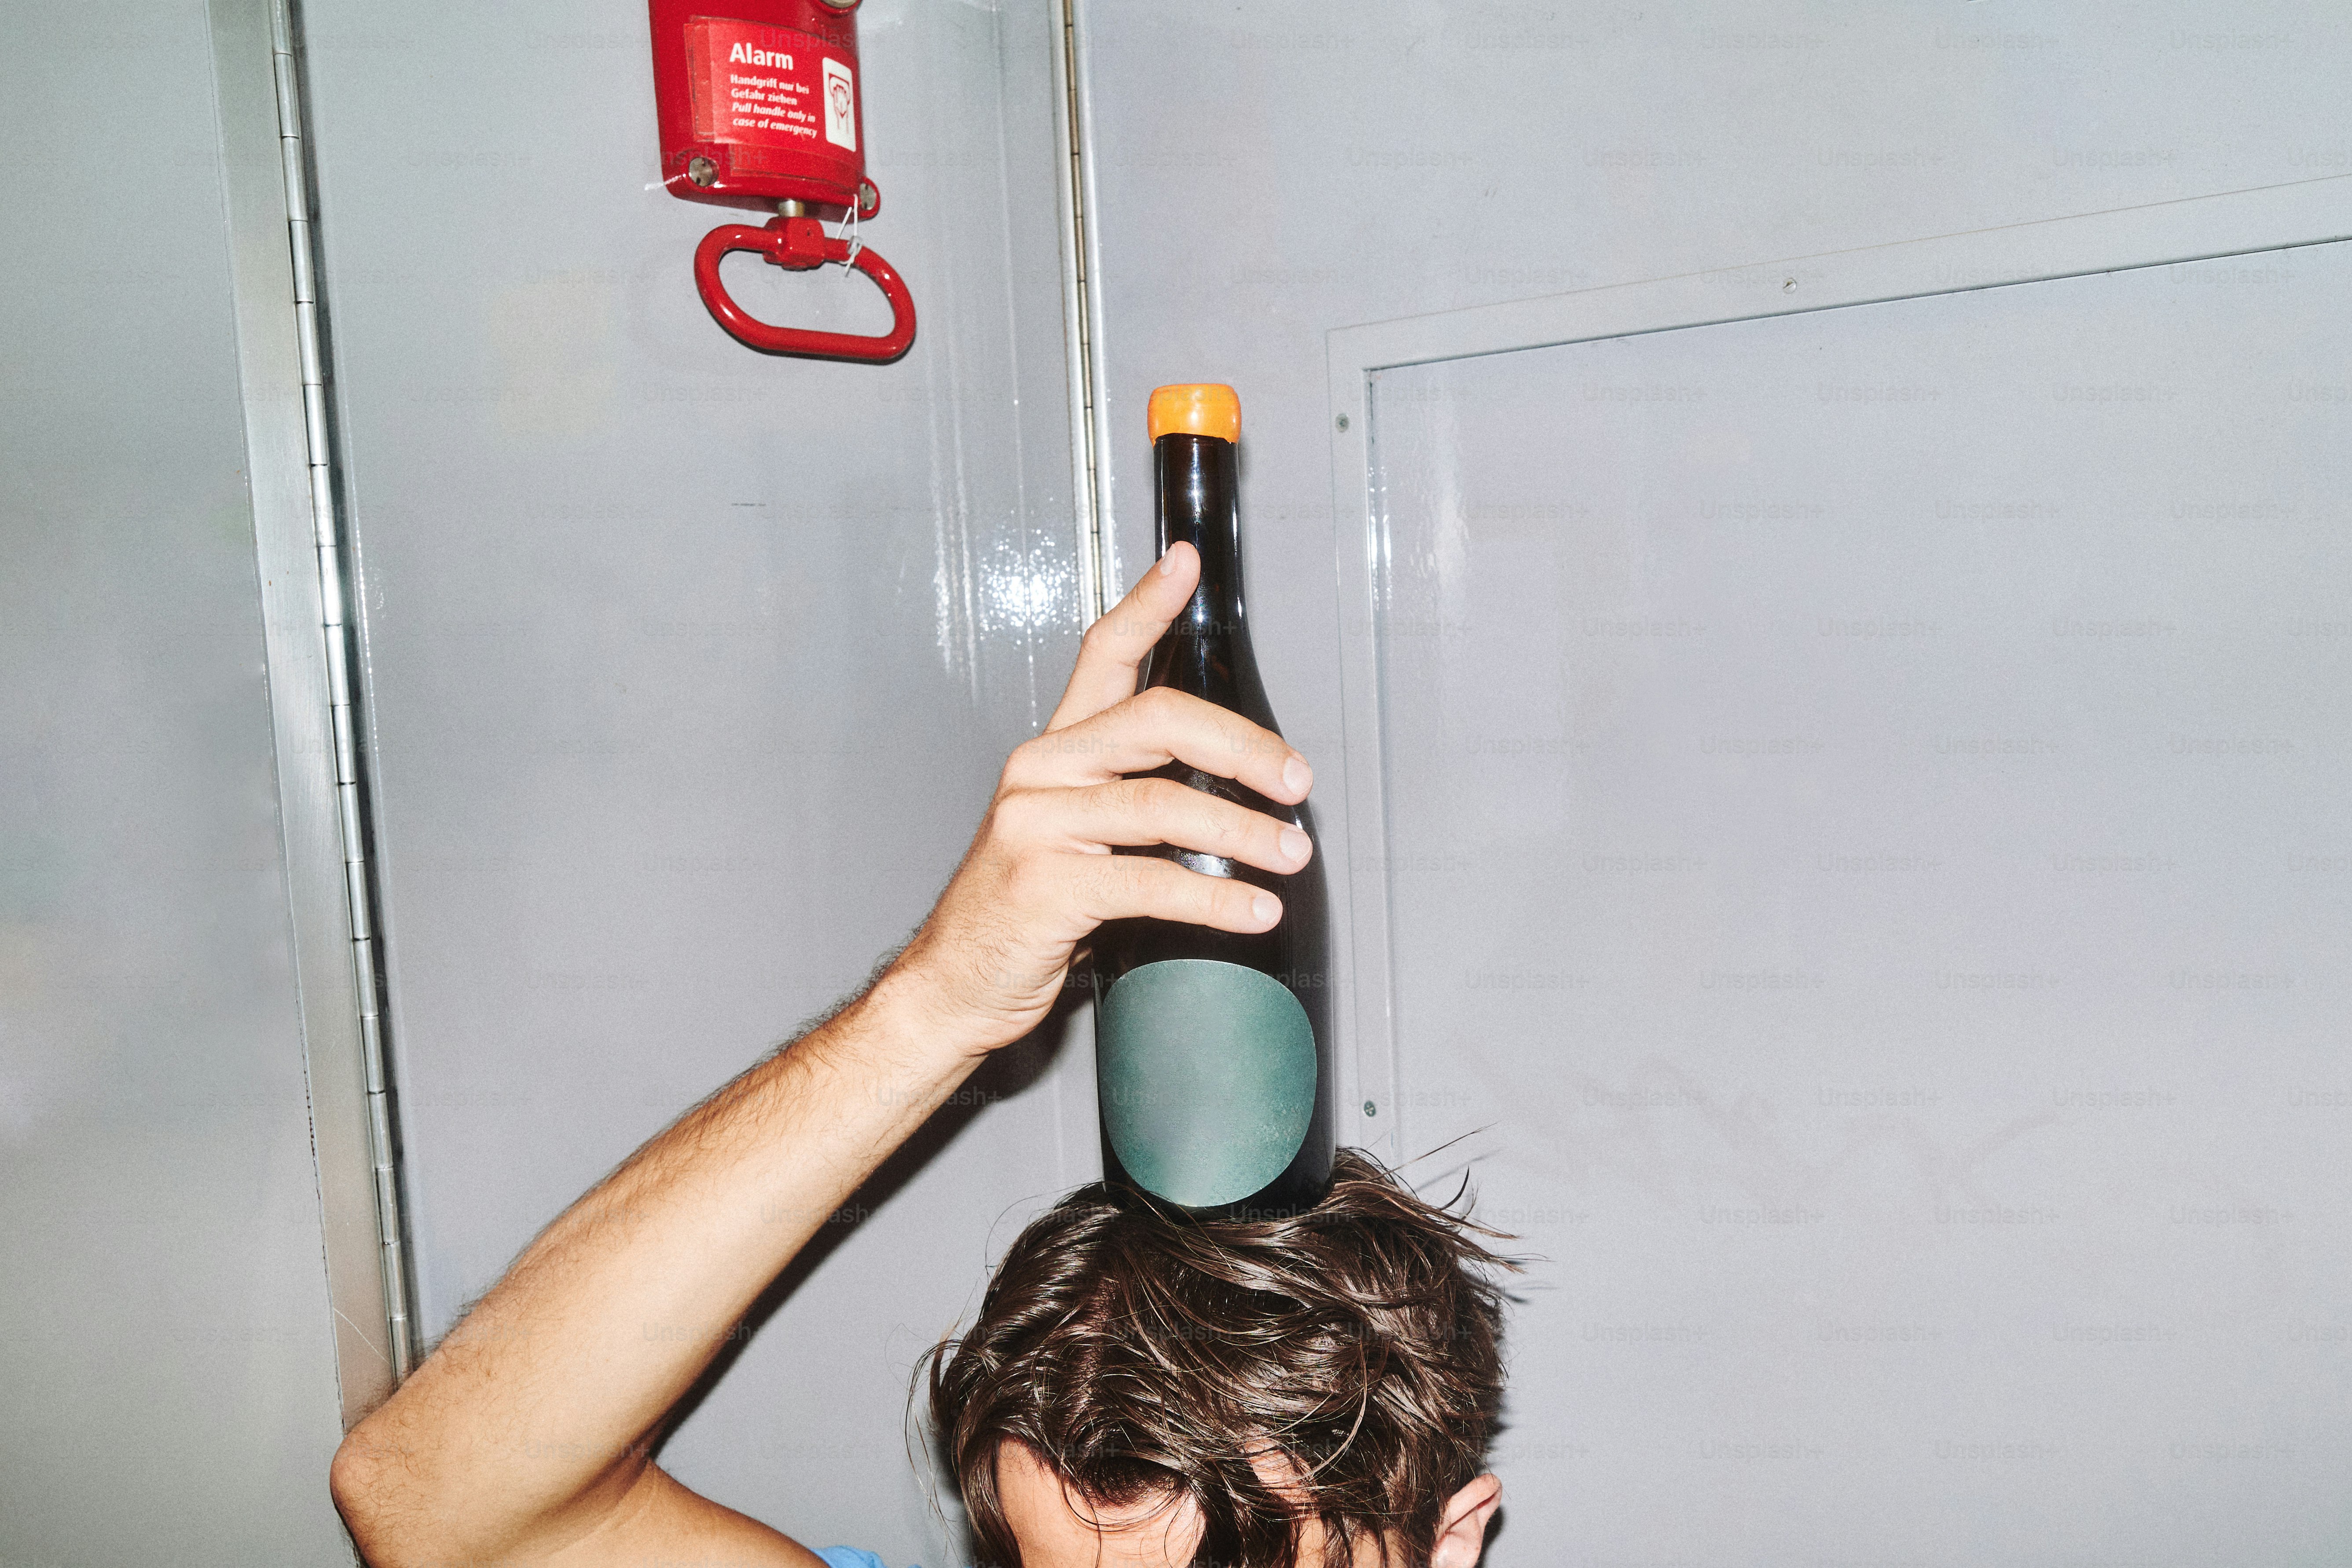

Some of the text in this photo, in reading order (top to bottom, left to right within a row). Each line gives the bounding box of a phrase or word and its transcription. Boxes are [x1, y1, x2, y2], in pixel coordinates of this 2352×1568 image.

[730, 43, 793, 70] Alarm
[730, 74, 809, 94] Handgriff nur bei
[731, 88, 797, 105] Gefahr ziehen
[732, 102, 815, 123] Pull handle only in
[733, 118, 817, 138] case of emergency
